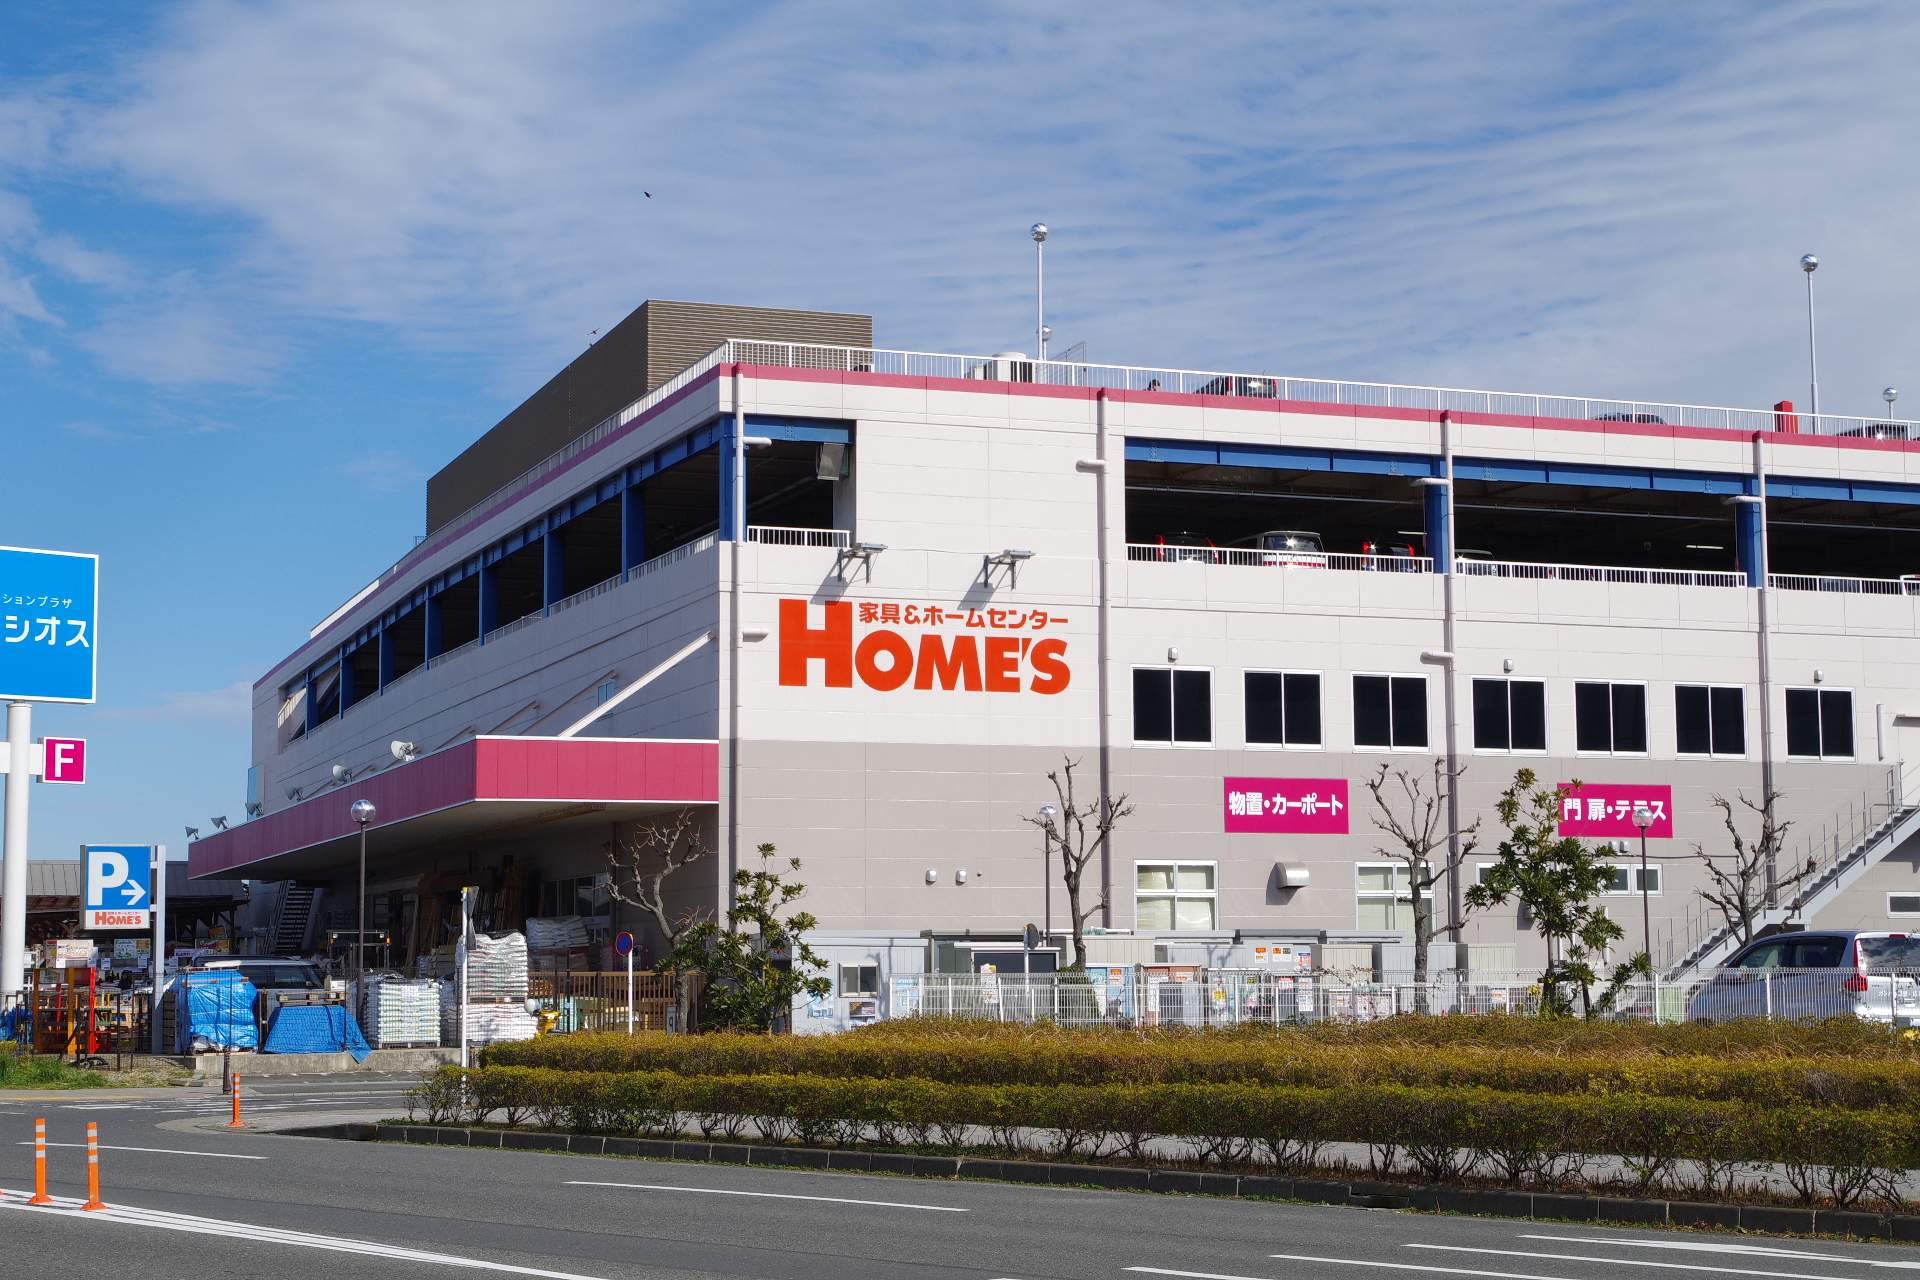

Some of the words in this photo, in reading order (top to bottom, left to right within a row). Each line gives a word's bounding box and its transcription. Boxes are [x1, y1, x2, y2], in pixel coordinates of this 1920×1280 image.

[2, 593, 73, 609] ションプラザ
[858, 601, 1069, 630] 家具&ホームセンター
[5, 615, 90, 648] シオス
[54, 743, 75, 778] F
[1229, 791, 1344, 816] 物置・カーポート
[88, 851, 129, 906] P
